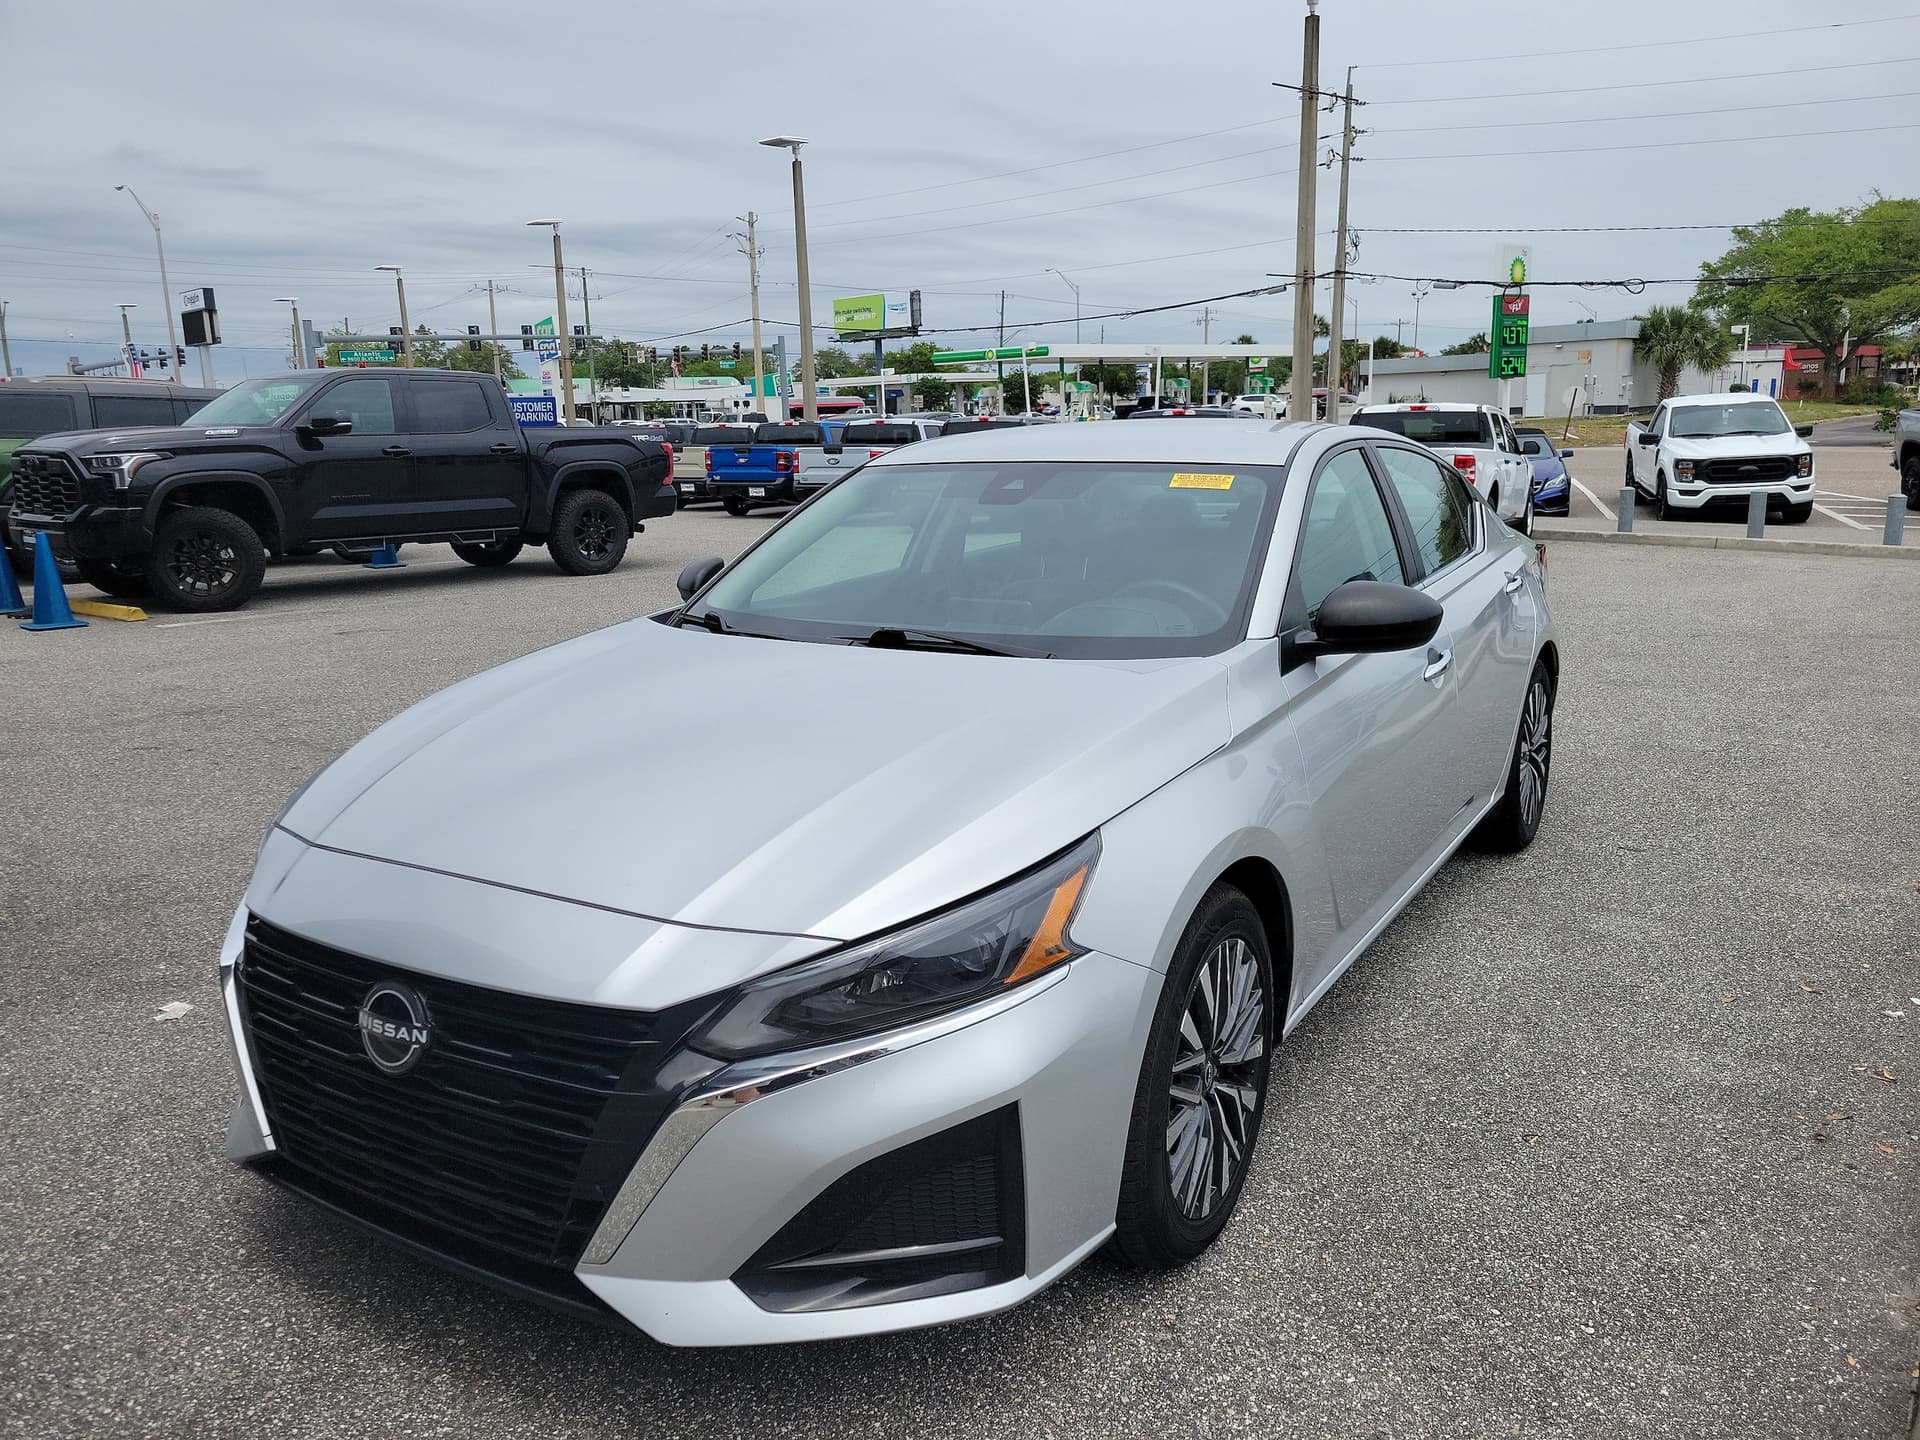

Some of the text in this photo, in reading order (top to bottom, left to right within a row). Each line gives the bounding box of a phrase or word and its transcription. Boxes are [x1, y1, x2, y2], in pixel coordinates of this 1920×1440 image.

[511, 402, 553, 412] USTOMER
[515, 412, 554, 422] PARKING
[359, 1009, 427, 1043] NISSAN
